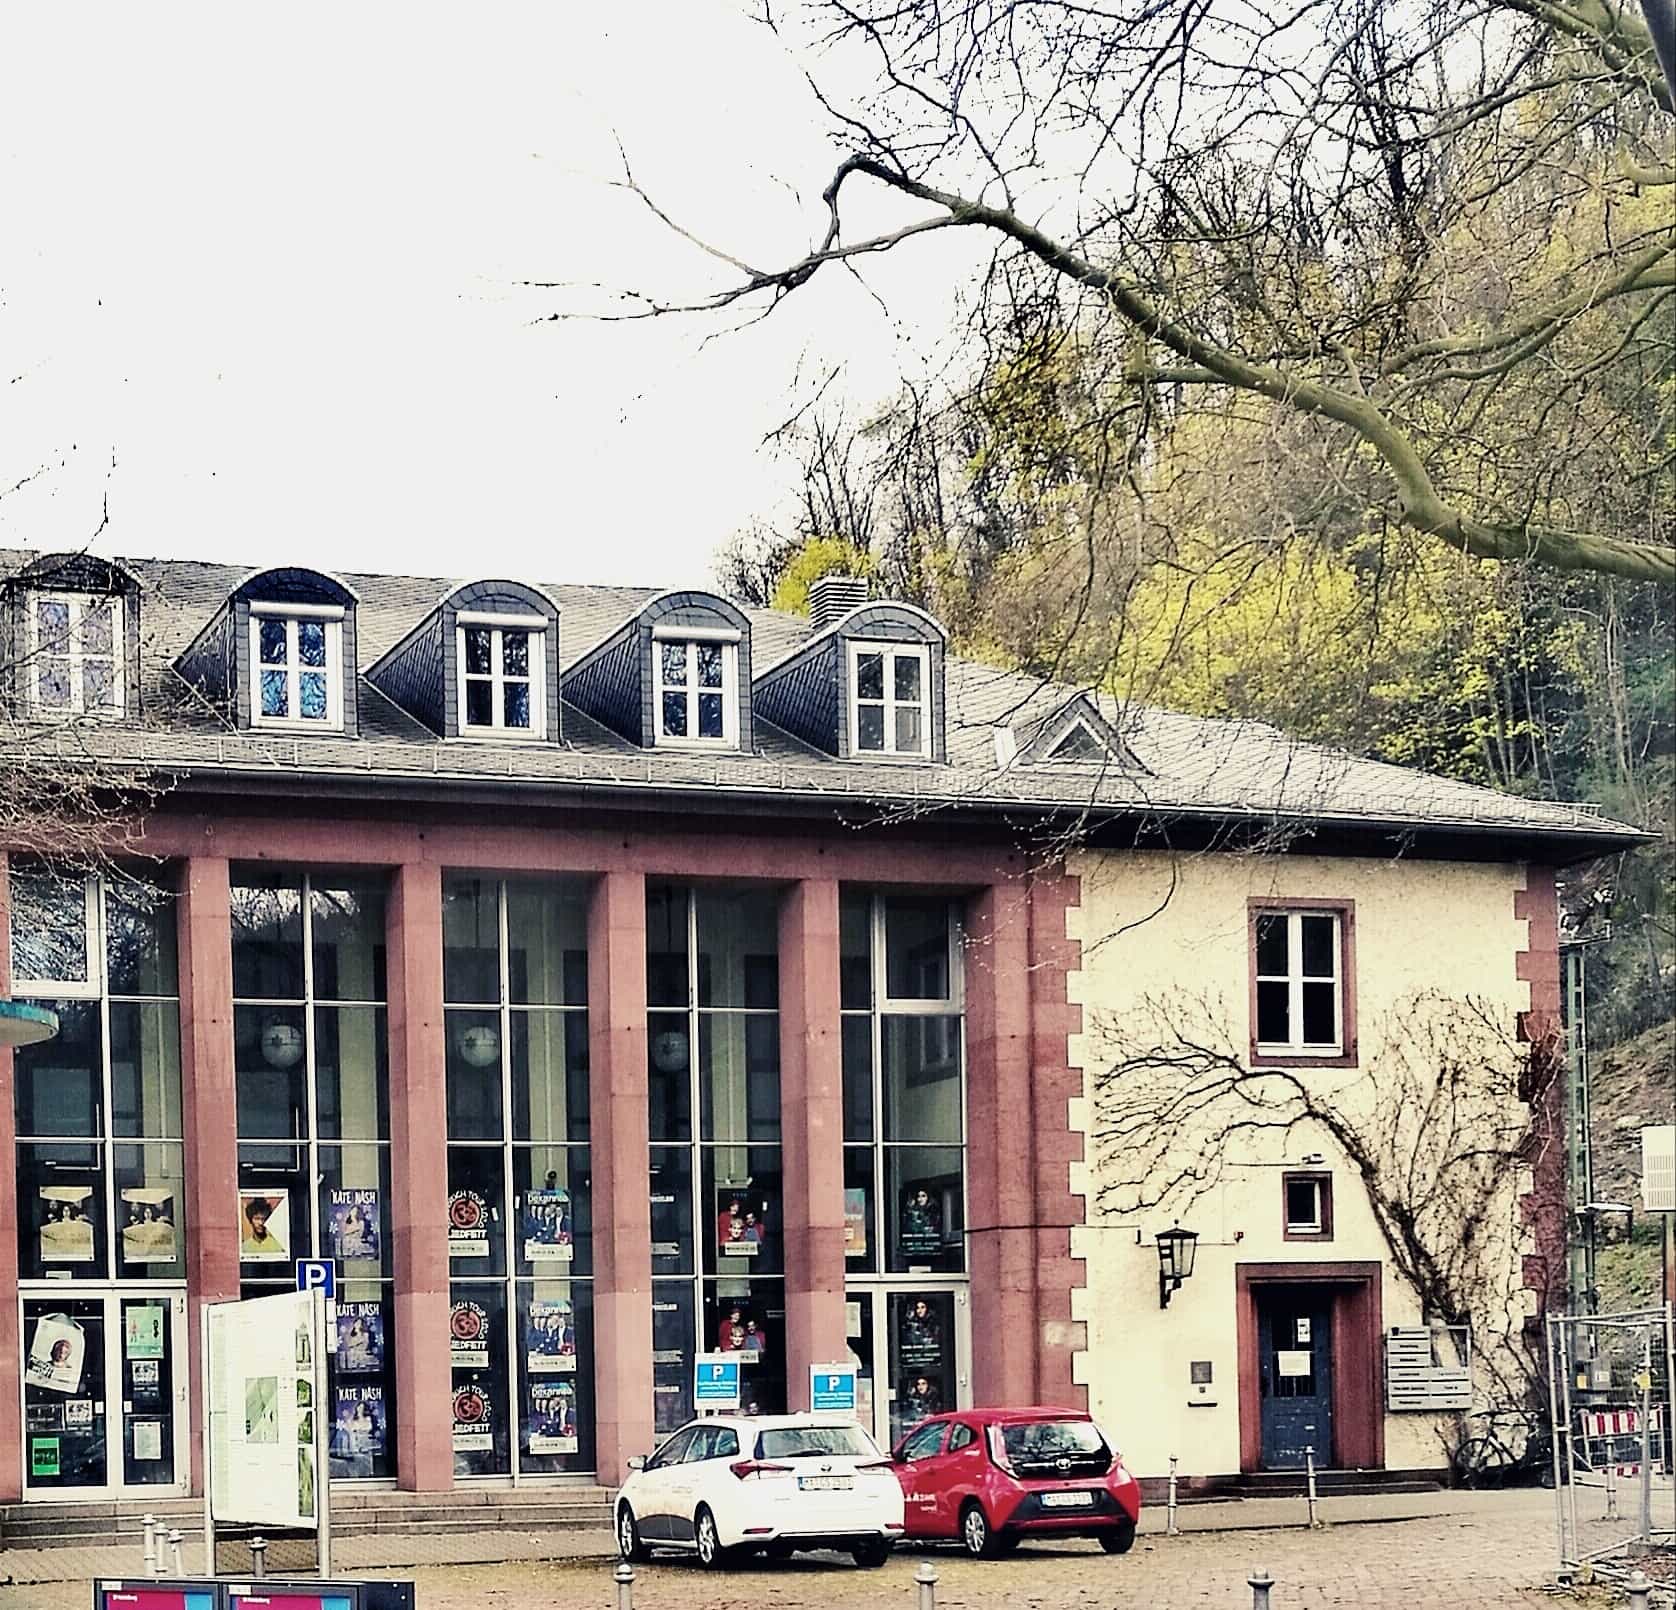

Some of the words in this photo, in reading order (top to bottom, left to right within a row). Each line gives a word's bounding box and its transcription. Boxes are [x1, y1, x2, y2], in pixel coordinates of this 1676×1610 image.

[331, 1190, 352, 1204] KATE
[355, 1189, 376, 1203] NASH
[305, 1264, 327, 1290] P
[336, 1304, 354, 1317] KATE
[358, 1303, 379, 1317] NASH
[712, 1365, 725, 1380] P
[828, 1376, 841, 1392] P
[336, 1386, 357, 1401] KATE
[361, 1386, 382, 1401] NASH
